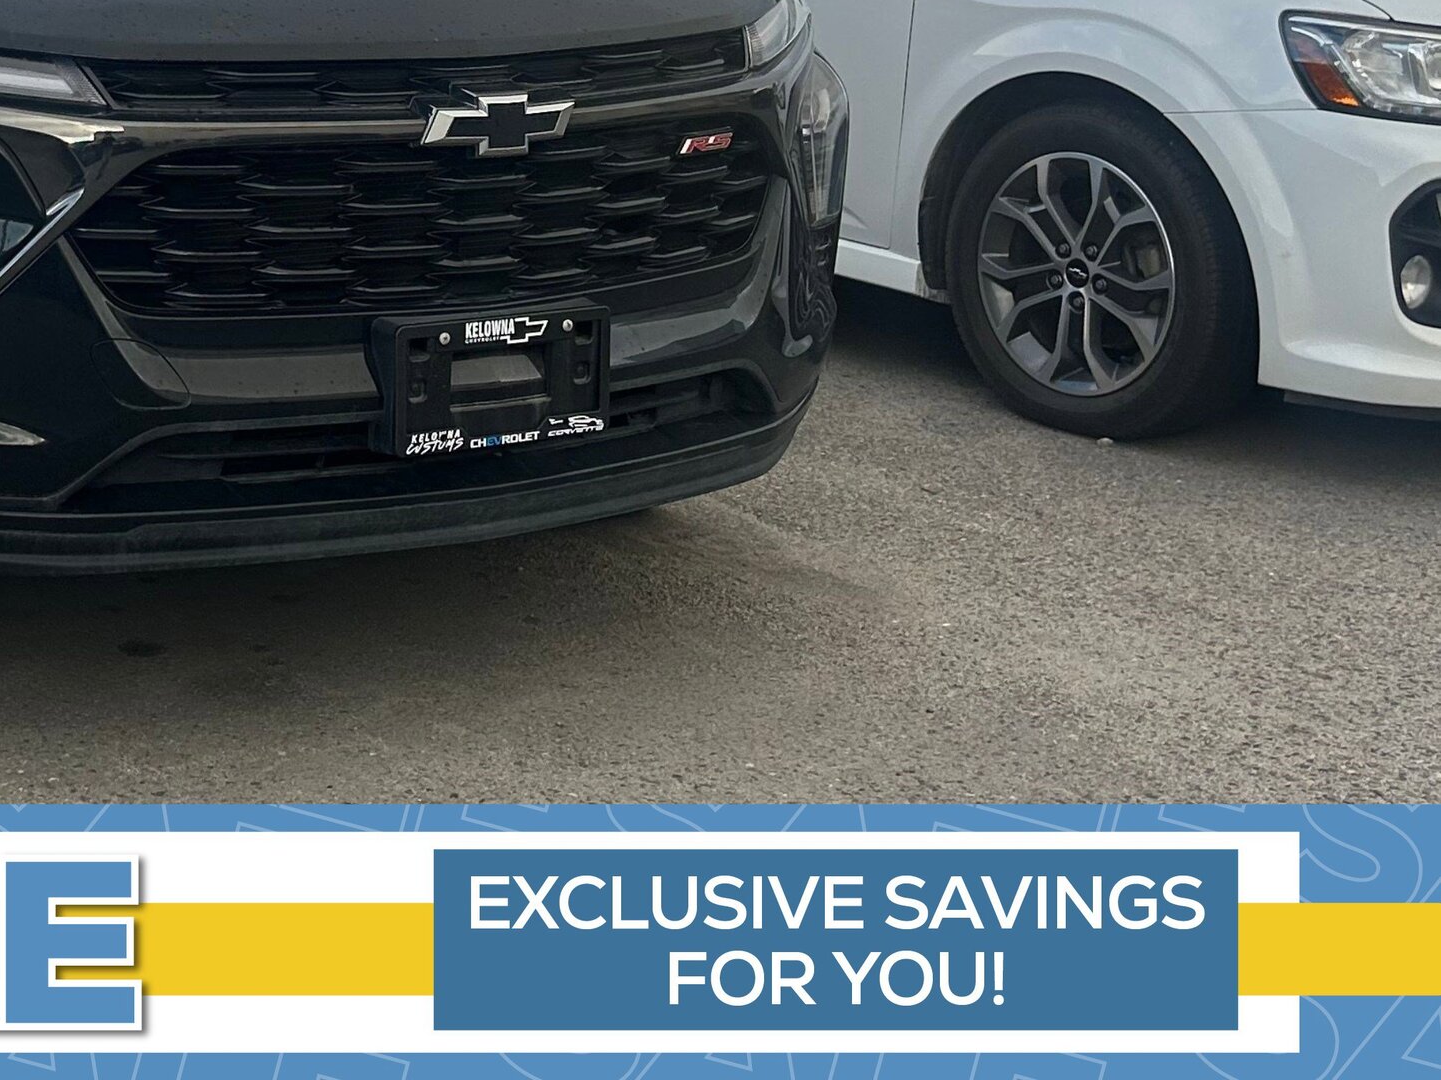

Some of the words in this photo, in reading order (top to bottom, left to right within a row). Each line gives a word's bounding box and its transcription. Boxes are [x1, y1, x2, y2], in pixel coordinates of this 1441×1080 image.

[679, 131, 734, 155] RS
[465, 318, 515, 338] KELOWNA
[470, 431, 540, 448] CHEVROLET
